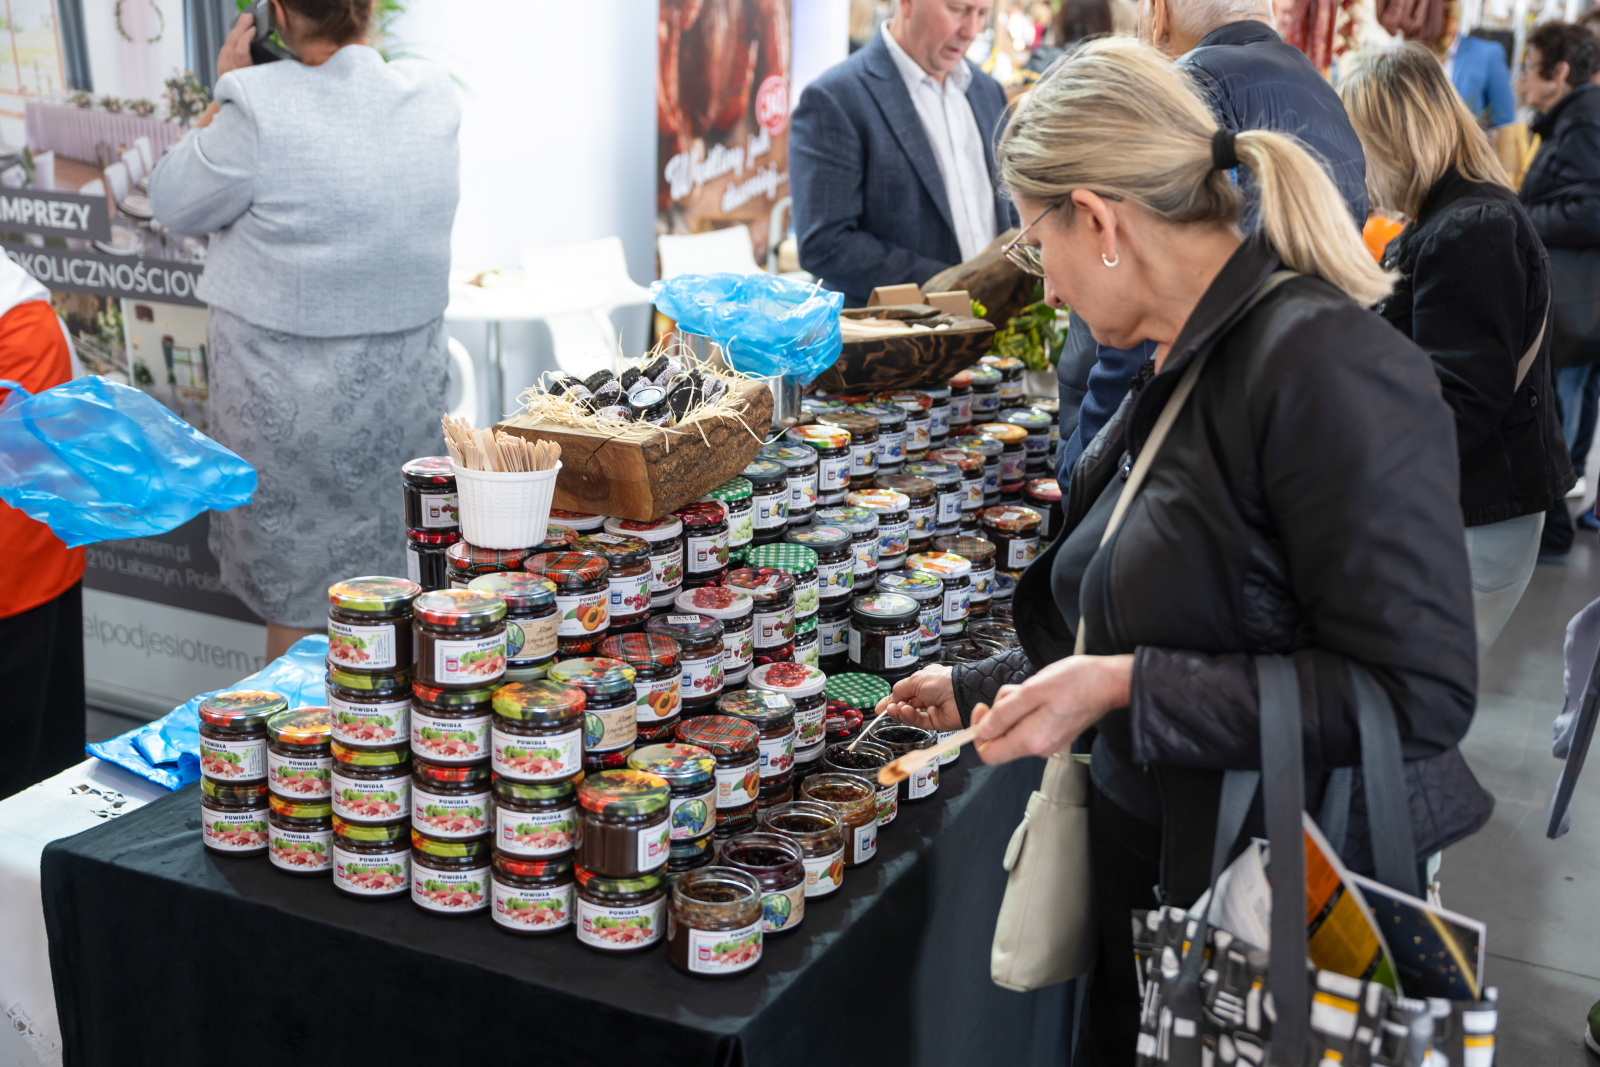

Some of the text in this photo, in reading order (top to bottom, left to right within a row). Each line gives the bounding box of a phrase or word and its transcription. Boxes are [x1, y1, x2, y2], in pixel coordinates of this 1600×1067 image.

[0, 195, 91, 231] MPREZY
[579, 594, 602, 603] POWIDŁA
[331, 623, 352, 633] POWIDŁA
[477, 638, 501, 648] POWIDŁA
[651, 680, 674, 689] POWIDŁA
[349, 705, 378, 713] POWIDŁA
[204, 740, 227, 749] POWIDŁA
[531, 813, 562, 821] POWIDŁA
[283, 832, 310, 840] POWIDŁA
